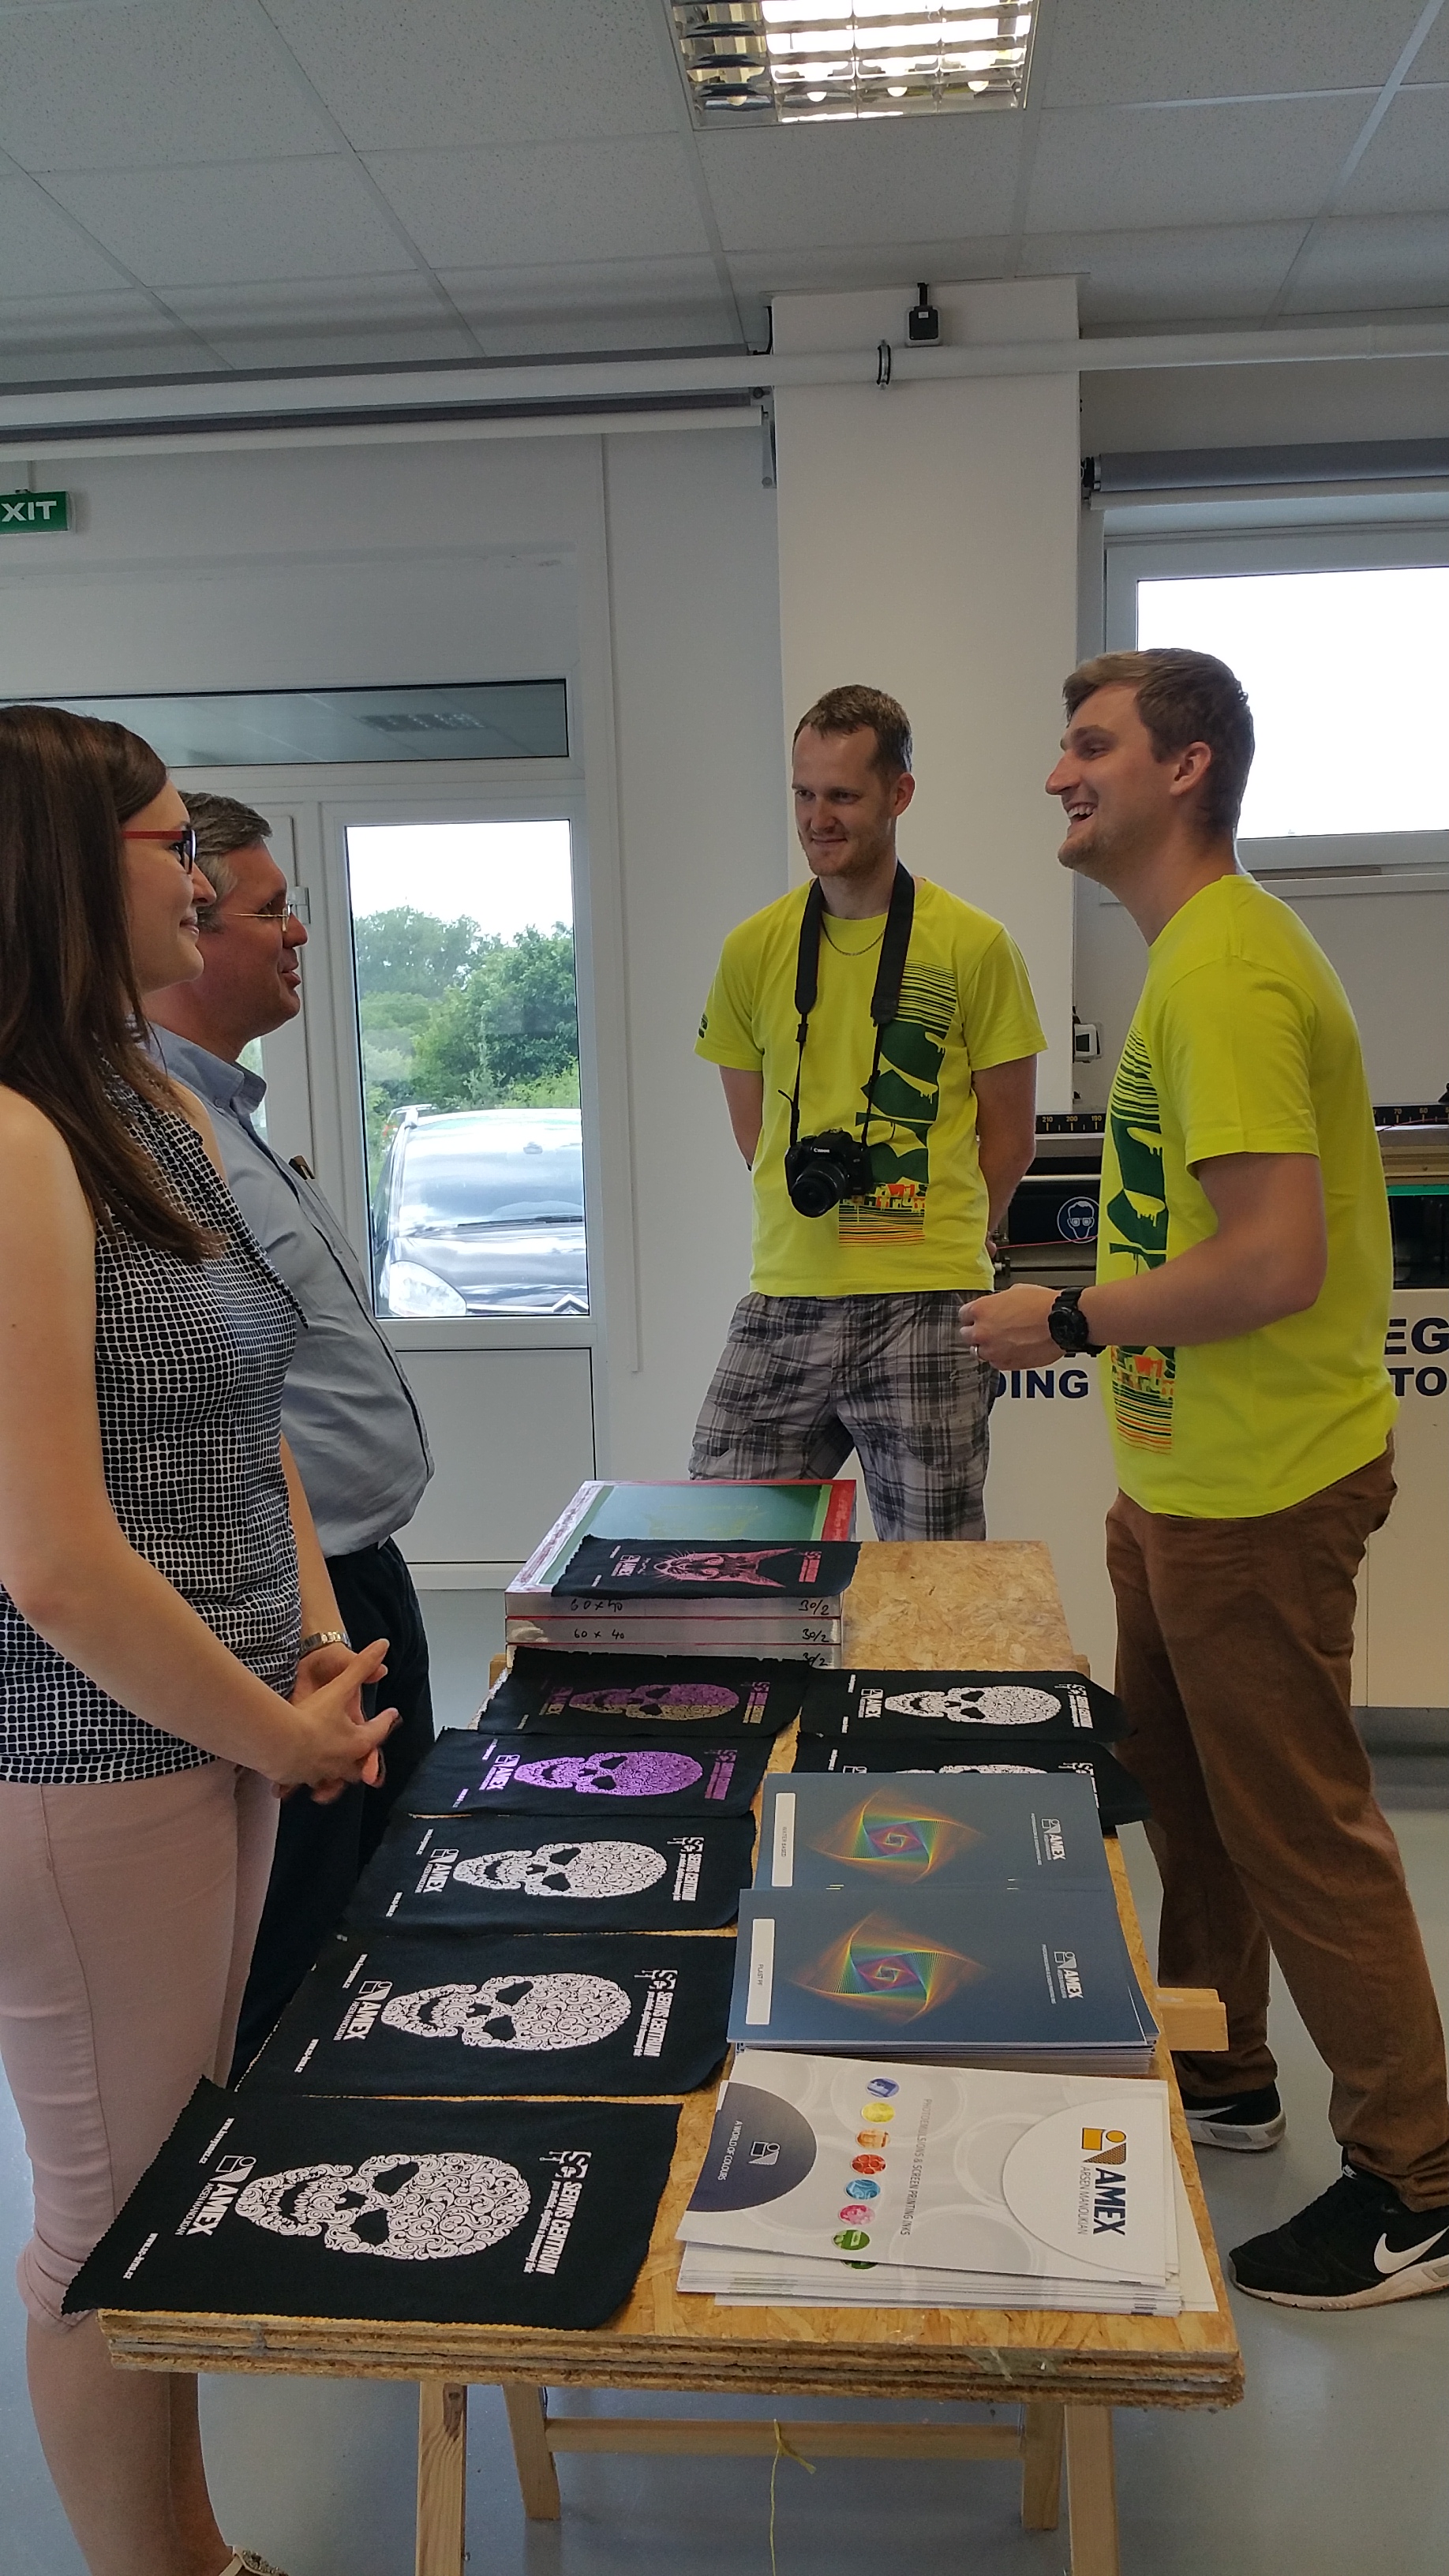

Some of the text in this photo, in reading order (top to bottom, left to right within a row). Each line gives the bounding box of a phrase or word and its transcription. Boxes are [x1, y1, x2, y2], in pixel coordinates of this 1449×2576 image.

[799, 1599, 829, 1616] 30/2
[574, 1629, 588, 1638] 60
[612, 1629, 625, 1639] 40
[802, 1628, 829, 1642] 30/2
[865, 1698, 882, 1717] AMEX
[486, 1767, 514, 1790] AMEX
[1050, 1834, 1065, 1859] AMEX
[423, 1863, 452, 1893] AMEX
[1064, 1969, 1084, 1998] AMEX
[653, 1992, 673, 2017] SERVIS
[343, 2001, 381, 2040] AMEX
[644, 2018, 668, 2057] CENTRUM
[729, 2125, 741, 2146] WORLD
[915, 2099, 932, 2157] PHOTOEMULSIONS
[727, 2147, 735, 2155] OF
[717, 2155, 732, 2180] COLOURS
[909, 2165, 922, 2189] SCREEN
[174, 2183, 214, 2236] ARSEN MANOUKIAN
[186, 2183, 239, 2236] AMEX
[904, 2190, 918, 2219] PRINTING
[1078, 2166, 1091, 2235] ARSEN MANOUKIAN
[1093, 2168, 1125, 2235] AMEX
[536, 2181, 582, 2275] SERVIS CENTRUM
[900, 2220, 912, 2235] INKS
